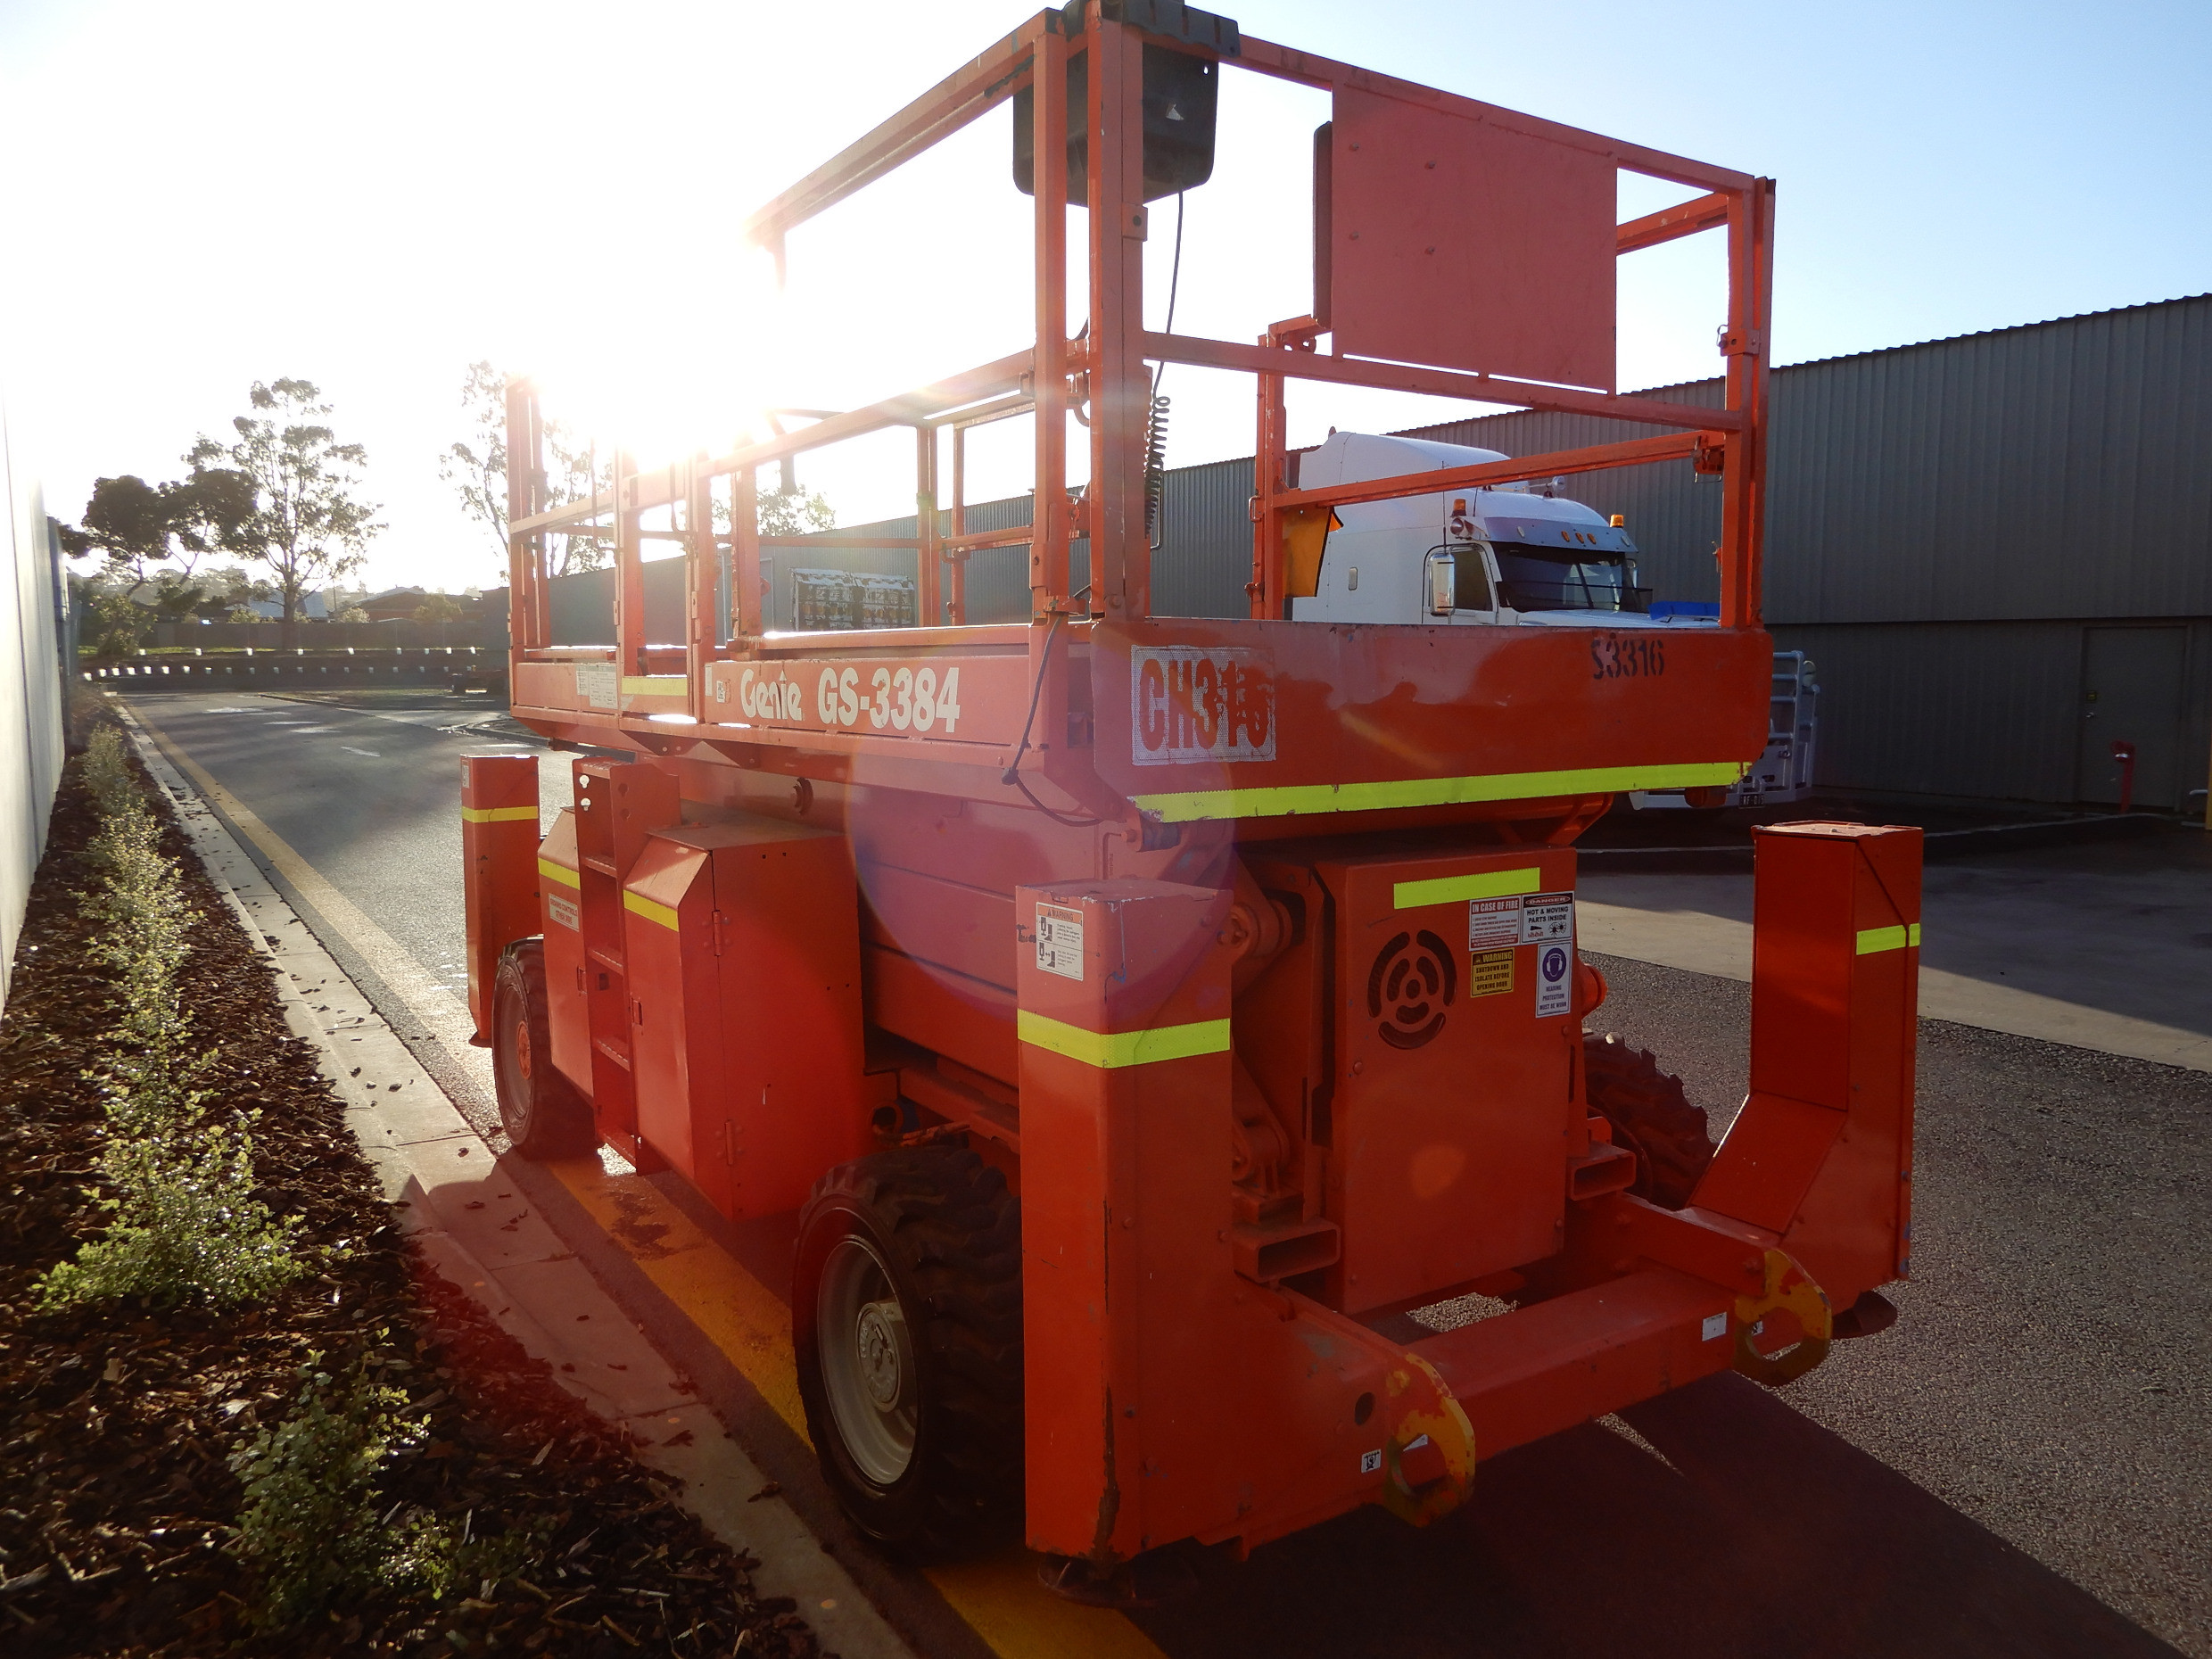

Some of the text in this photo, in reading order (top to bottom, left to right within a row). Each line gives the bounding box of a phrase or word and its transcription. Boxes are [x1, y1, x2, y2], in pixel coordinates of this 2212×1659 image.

[1591, 640, 1664, 680] S3316
[740, 667, 961, 732] Genie GS-3384
[1473, 899, 1518, 912] IN CASE OF FIRE
[1052, 909, 1074, 920] WARNING
[1482, 951, 1513, 962] WARNING
[1474, 974, 1492, 982] ISOLATE
